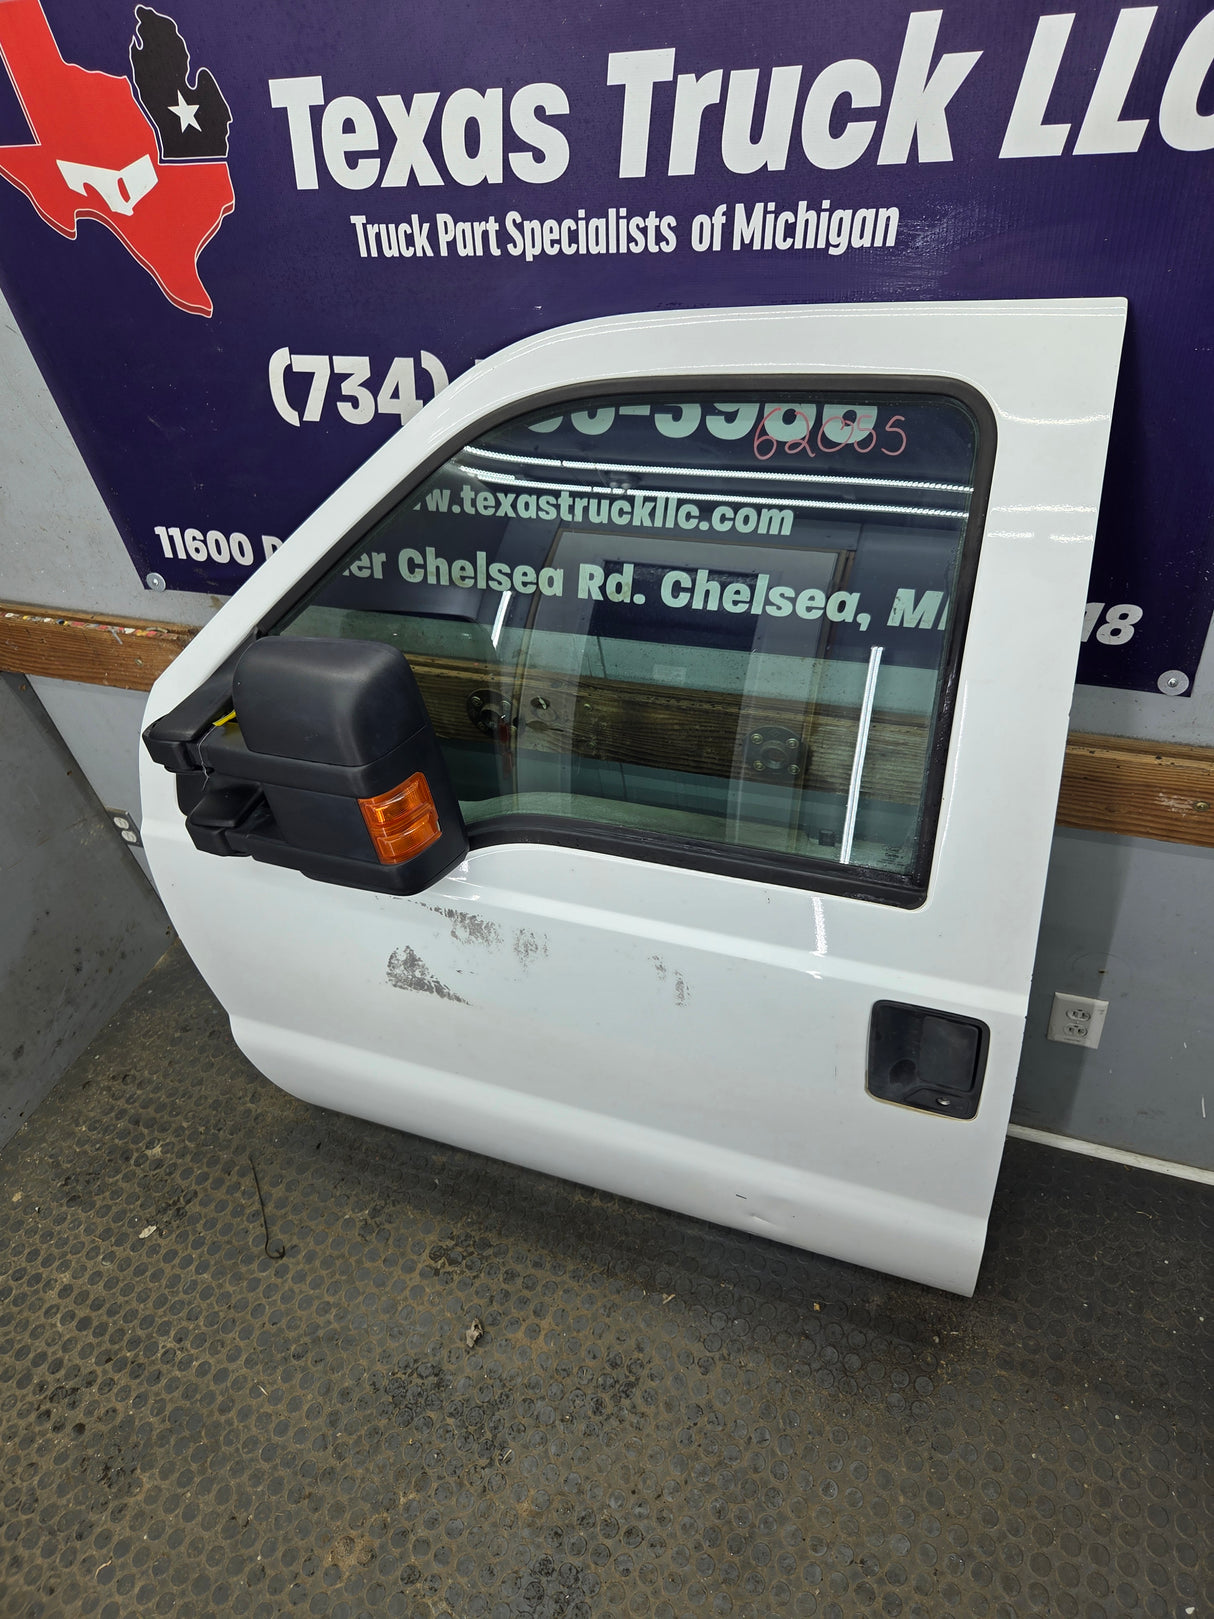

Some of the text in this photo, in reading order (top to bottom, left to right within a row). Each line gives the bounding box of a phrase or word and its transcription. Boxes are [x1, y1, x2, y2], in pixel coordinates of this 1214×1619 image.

[269, 75, 570, 191] Texas
[606, 8, 985, 179] Truck
[349, 199, 900, 262] Truck Part Specialists of Michigan
[268, 346, 451, 427] (734)
[753, 406, 907, 461] 62055
[153, 525, 254, 566] 11600
[398, 546, 563, 598] Chelsea
[577, 562, 646, 605] Rd.
[660, 568, 871, 632] Chelsea,
